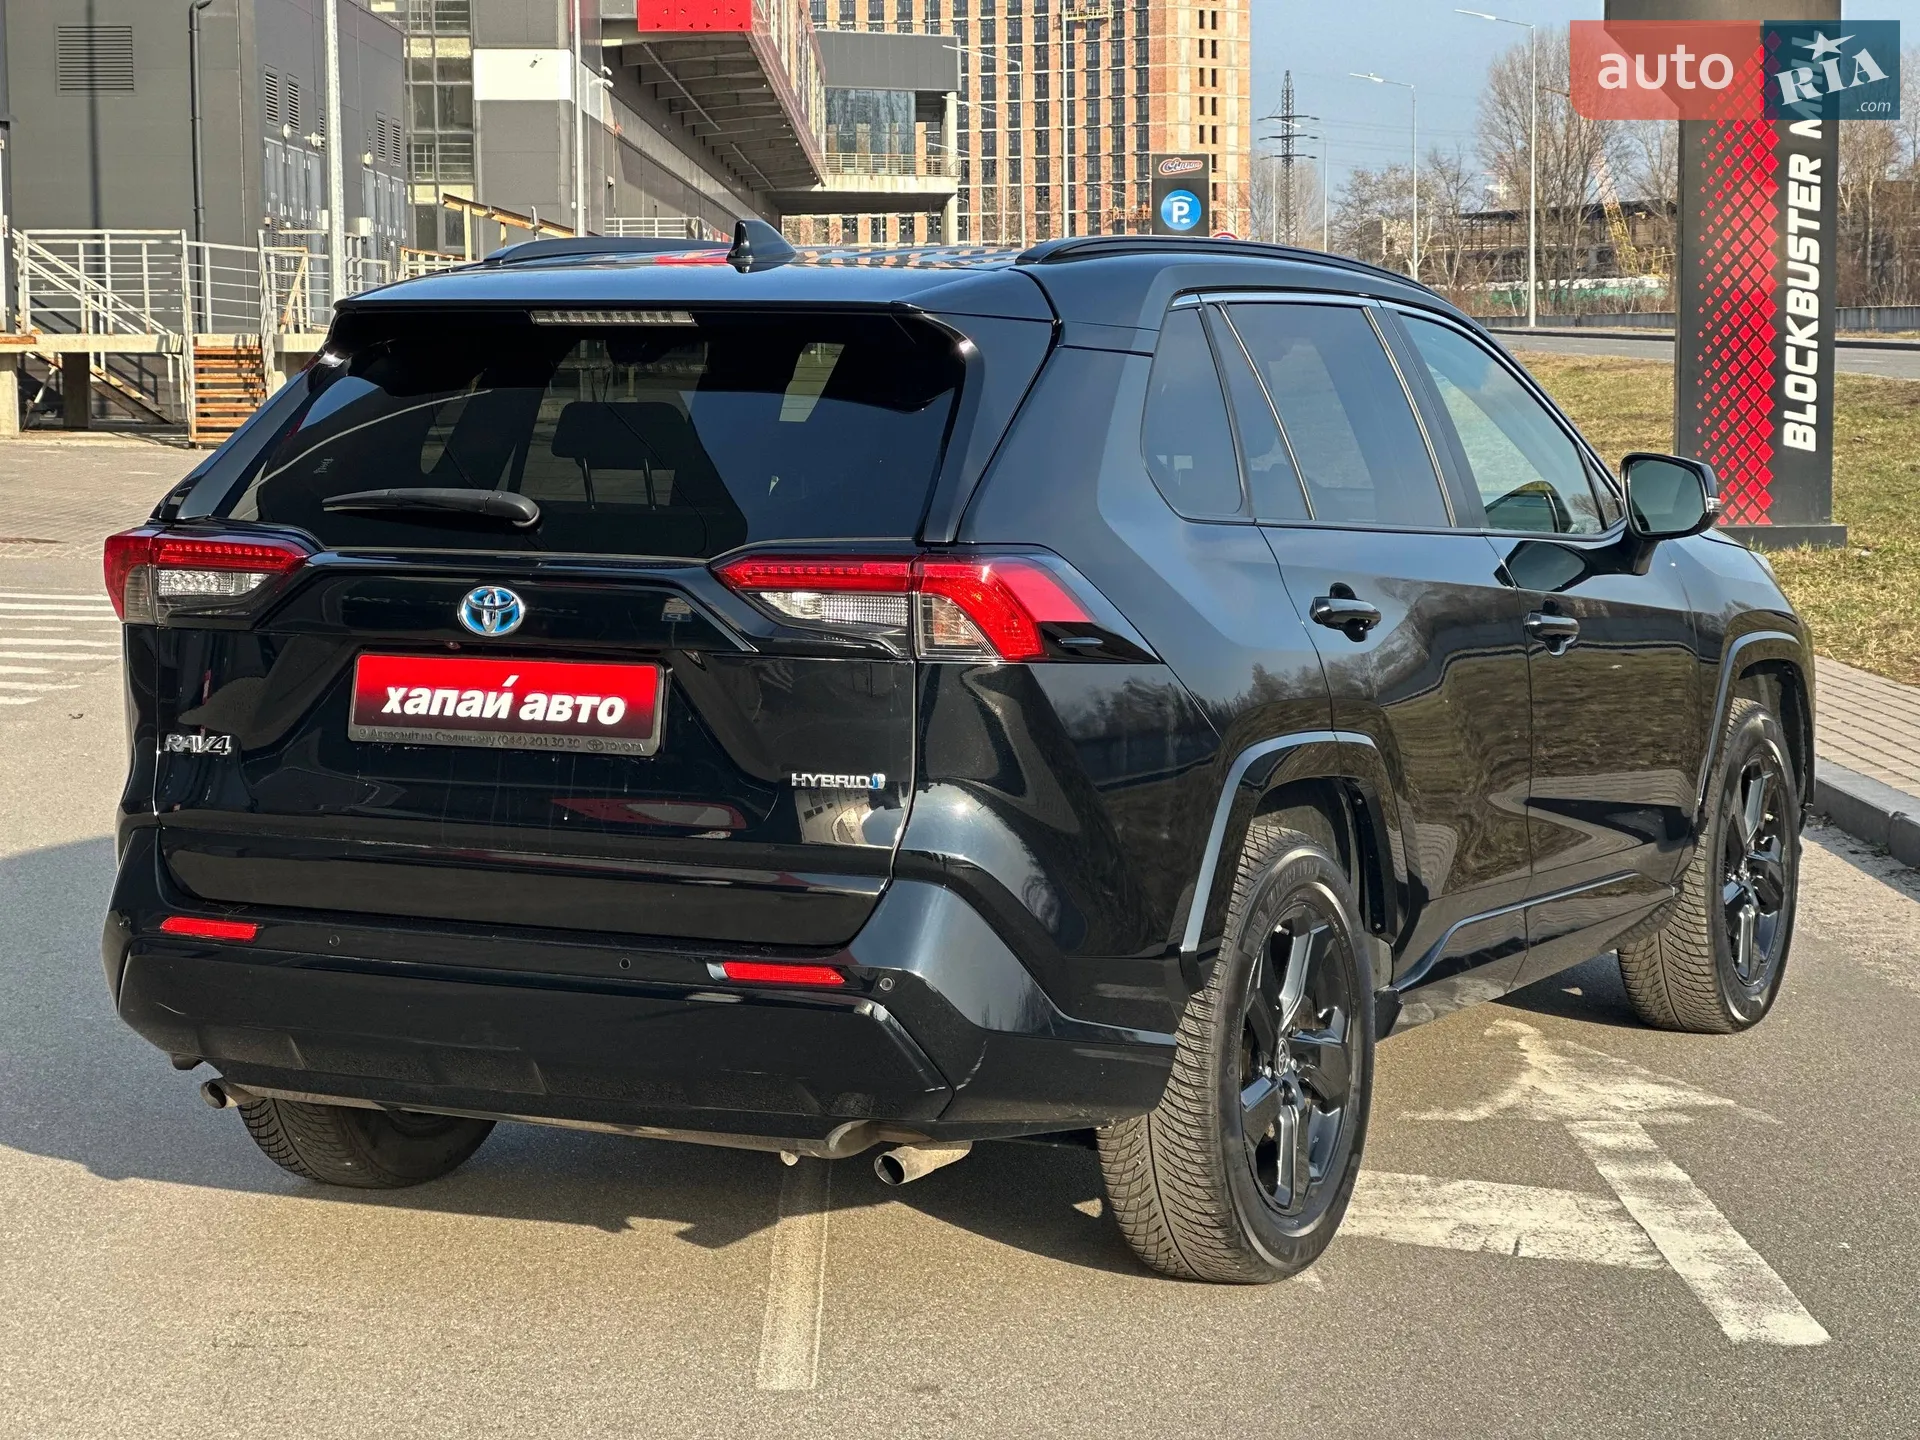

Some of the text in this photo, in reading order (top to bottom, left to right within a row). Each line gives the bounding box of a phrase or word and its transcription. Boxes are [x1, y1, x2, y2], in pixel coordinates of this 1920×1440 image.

[1172, 201, 1190, 223] P
[1783, 153, 1822, 452] BLOCKBUSTER
[519, 692, 626, 725] авто
[164, 733, 232, 755] RAV4
[529, 735, 548, 747] 201
[550, 737, 565, 748] 30
[567, 738, 581, 749] 30
[791, 772, 871, 788] HYBRID
